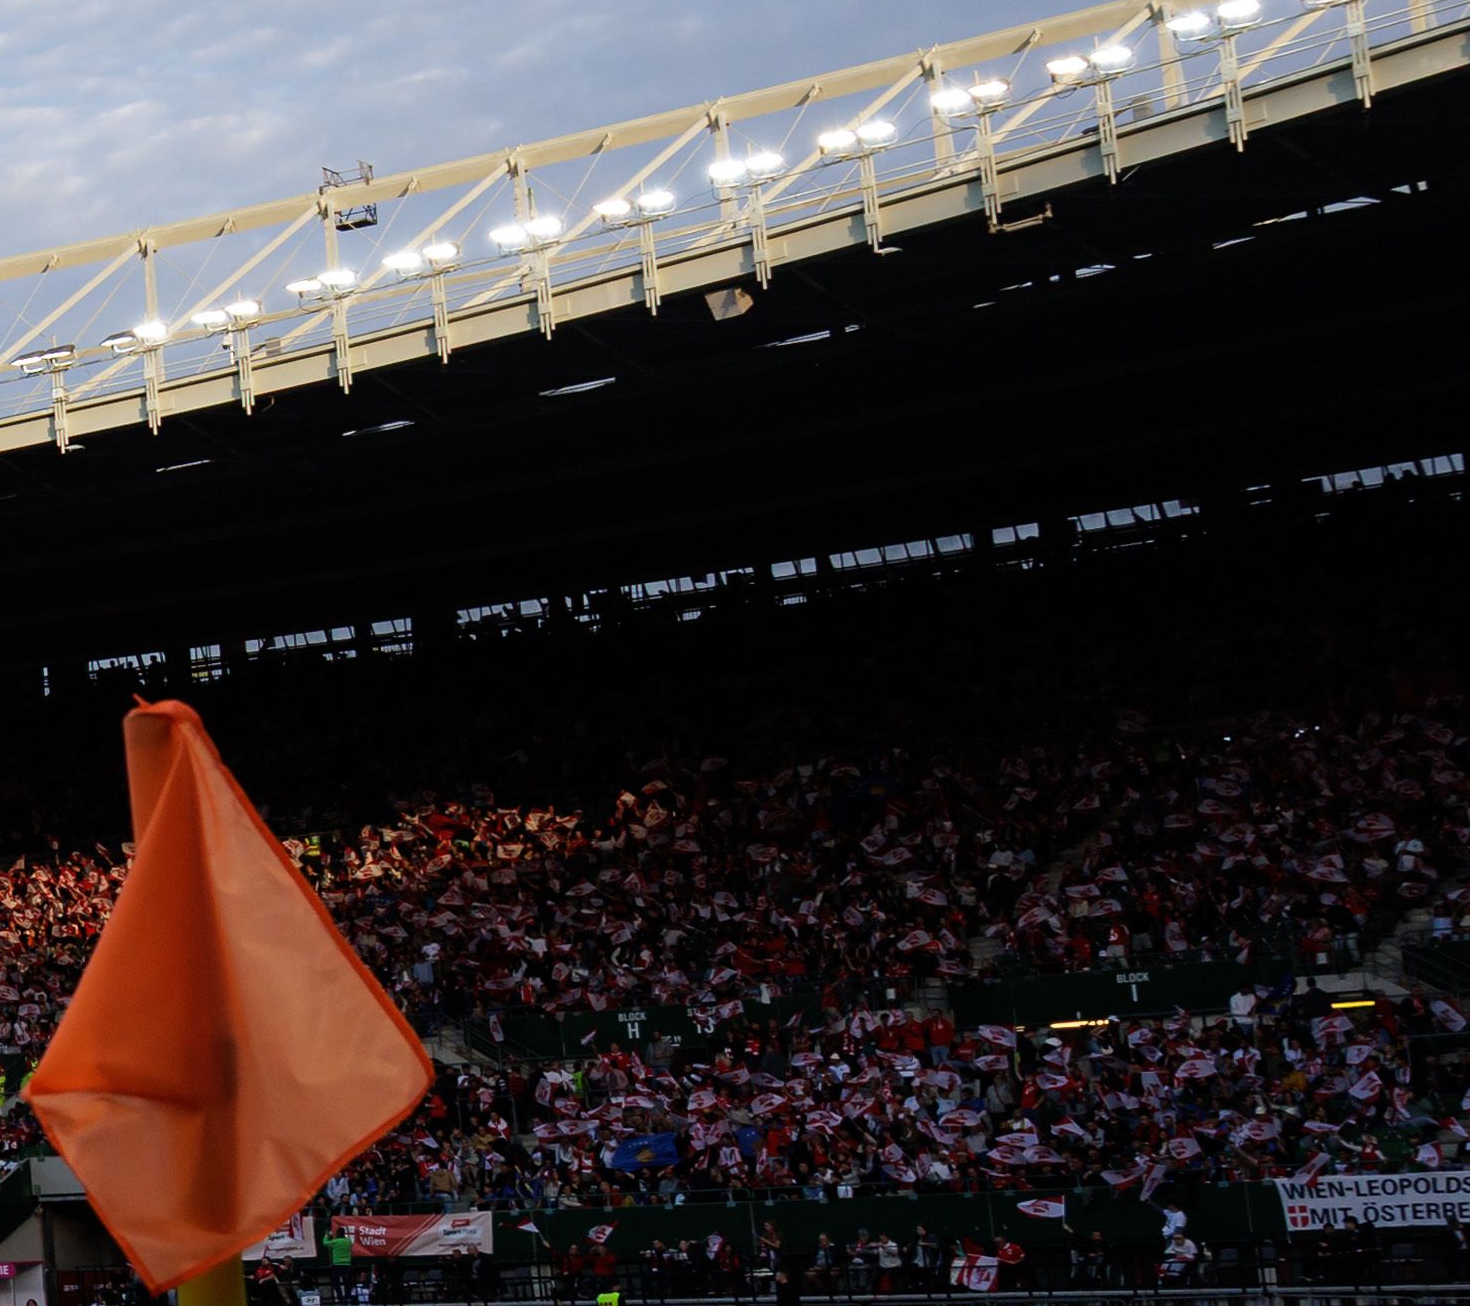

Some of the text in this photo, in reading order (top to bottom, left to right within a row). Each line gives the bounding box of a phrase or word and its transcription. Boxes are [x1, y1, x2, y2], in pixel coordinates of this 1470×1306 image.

[1116, 972, 1150, 983] BLOCK
[618, 1012, 646, 1022] BLOCK
[627, 1022, 640, 1039] H
[1310, 1207, 1353, 1225] MIT
[358, 1226, 387, 1236] Stadt
[359, 1236, 387, 1246] Wien
